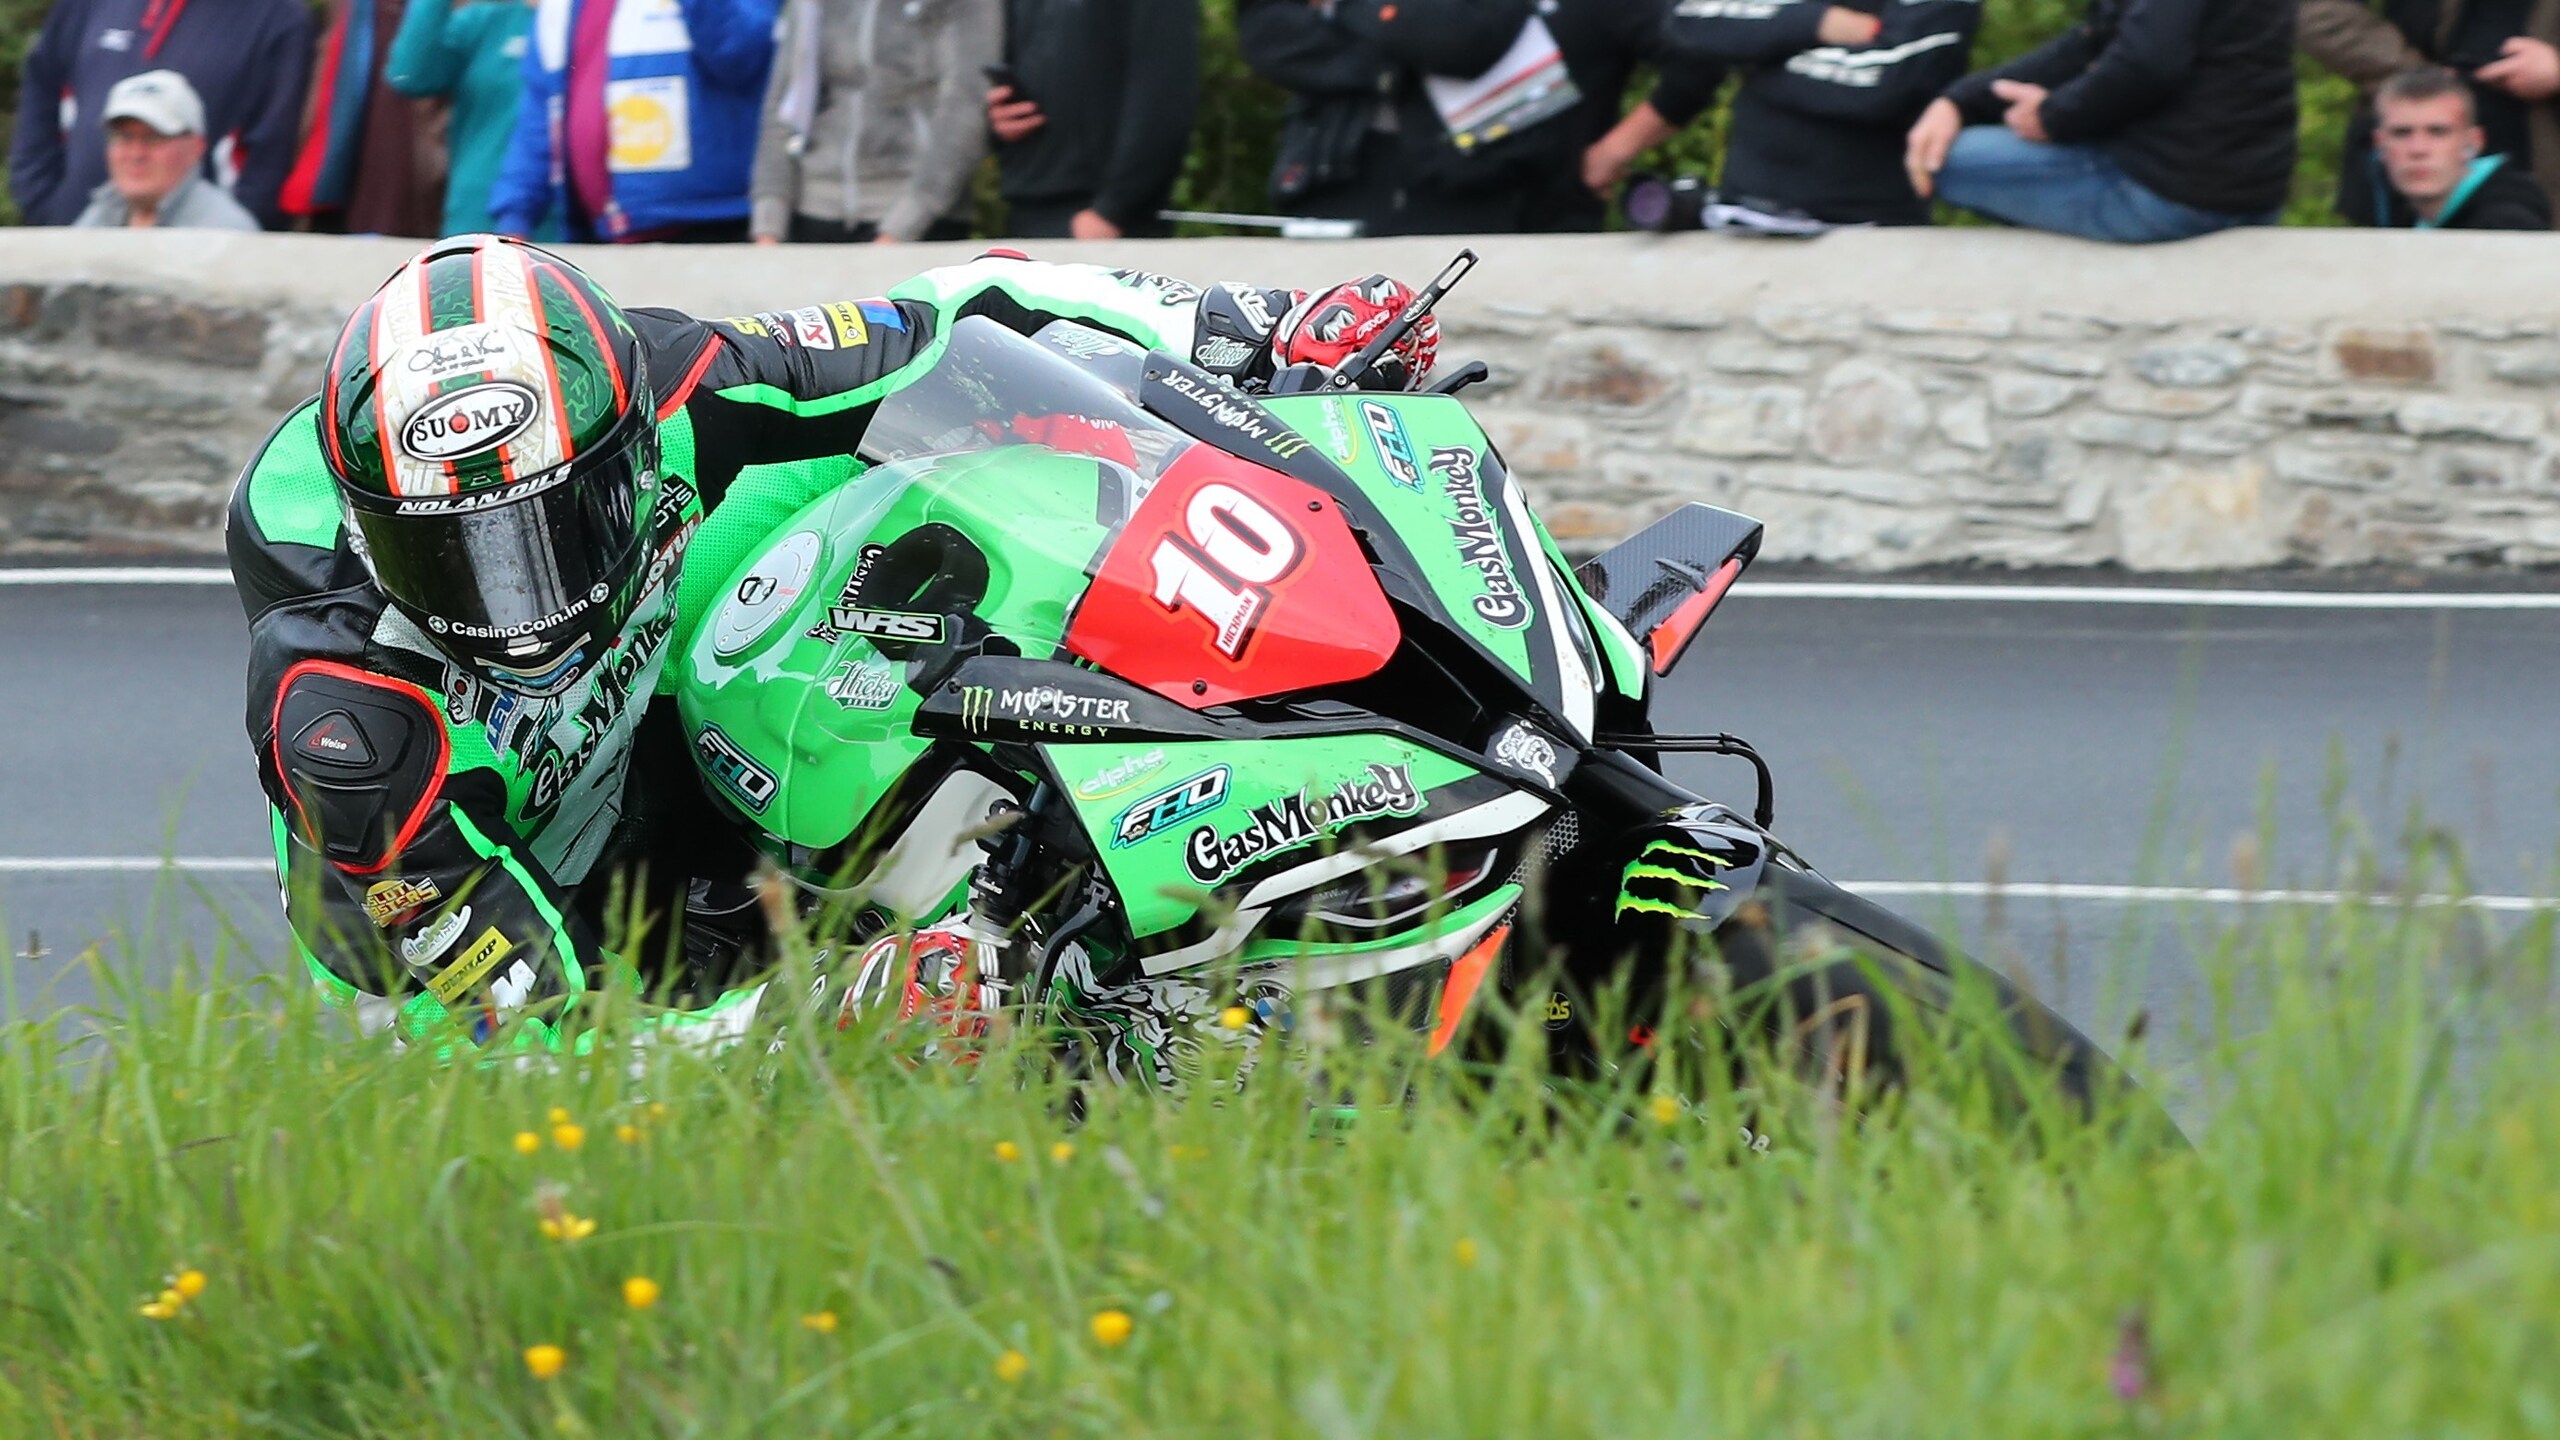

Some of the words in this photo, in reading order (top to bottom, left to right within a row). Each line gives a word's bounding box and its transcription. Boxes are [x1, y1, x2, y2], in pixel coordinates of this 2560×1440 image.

[414, 402, 522, 442] SUOMY
[1162, 369, 1268, 439] MONSTER
[398, 490, 502, 513] NOLAN
[506, 463, 573, 500] OILS
[1150, 481, 1302, 661] 10
[451, 599, 589, 639] CasinoCoin.im
[832, 608, 939, 638] WRS
[1222, 596, 1253, 649] HICKMAN
[320, 736, 348, 750] Weise
[1019, 719, 1108, 737] ENERGY
[698, 730, 775, 802] FHO
[1119, 768, 1228, 837] FHO
[1184, 763, 1421, 885] GasMonkey
